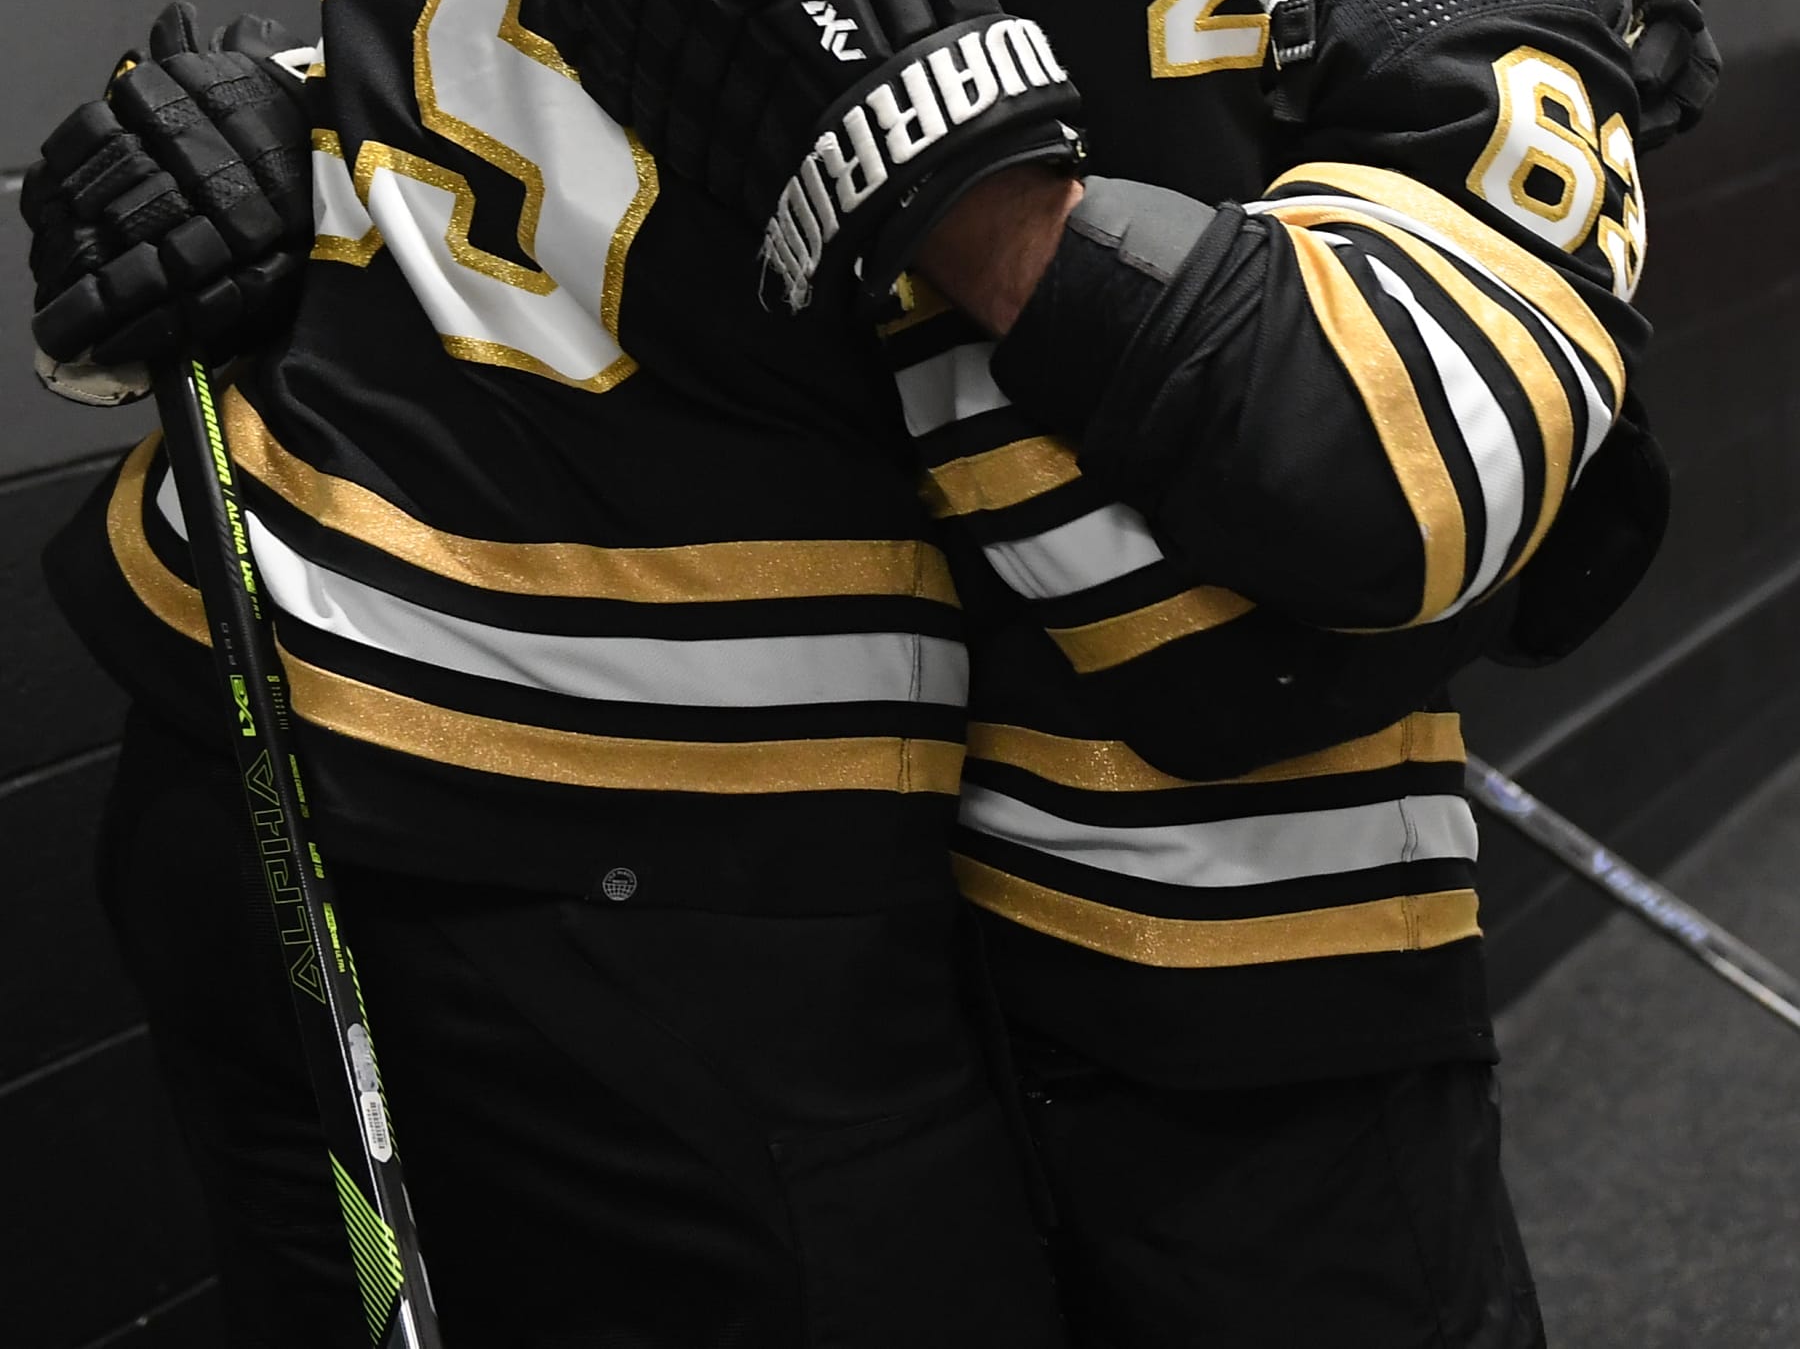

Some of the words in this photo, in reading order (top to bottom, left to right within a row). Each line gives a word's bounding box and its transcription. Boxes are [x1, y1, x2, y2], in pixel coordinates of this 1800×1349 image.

[193, 361, 232, 486] WARRIOR
[225, 499, 248, 555] ALPHA
[246, 749, 326, 1004] ALPHA
